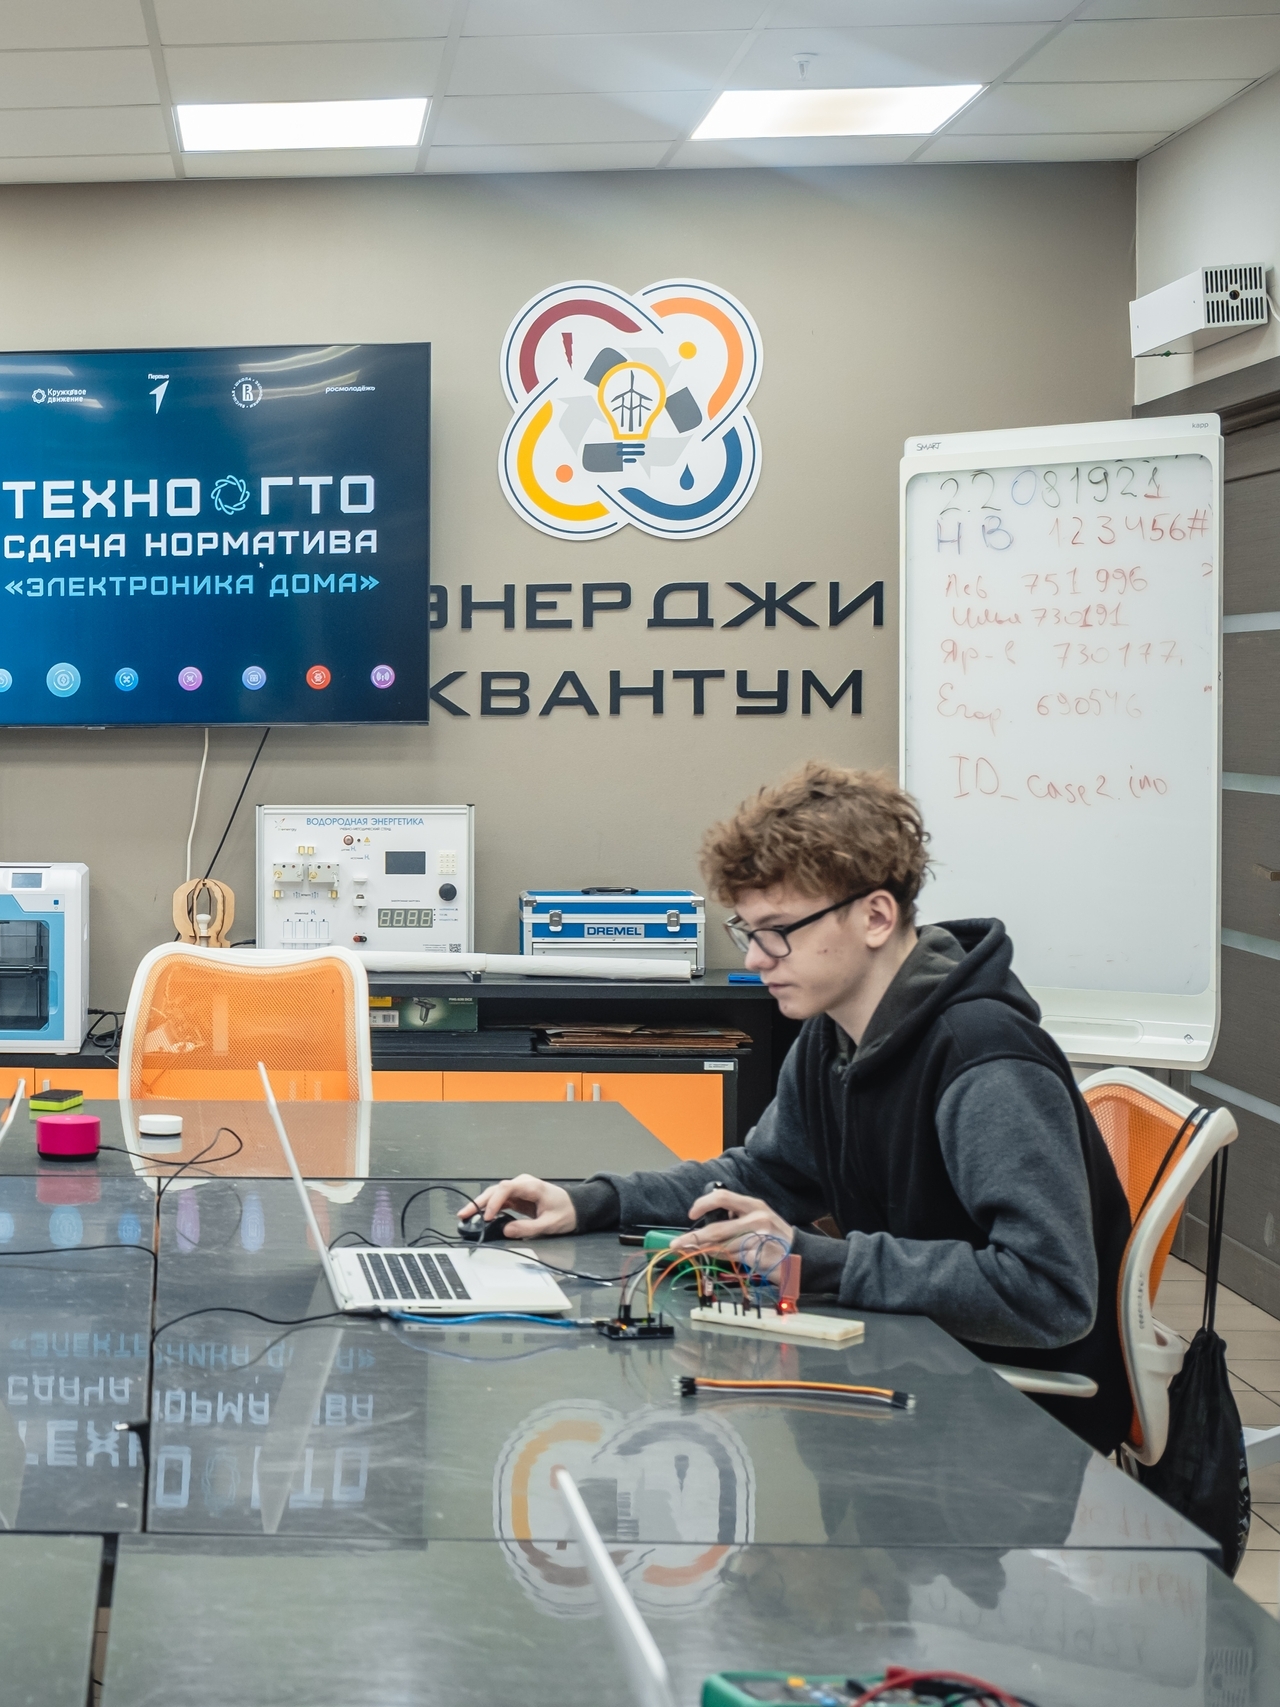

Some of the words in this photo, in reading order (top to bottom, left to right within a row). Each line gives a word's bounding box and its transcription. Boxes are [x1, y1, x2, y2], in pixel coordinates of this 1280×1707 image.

[1191, 421, 1209, 429] kapp
[916, 442, 942, 451] SMART
[2, 478, 201, 519] ТЕХНО
[260, 475, 375, 515] ГТО
[3, 533, 126, 563] СДАЧА
[145, 529, 378, 558] НОРМАТИВА
[4, 574, 254, 597] «ЭЛЕКТРОНИКА
[269, 573, 380, 597] ДОМА»
[429, 669, 863, 717] КВАНТУМ
[306, 818, 368, 826] ВОДОРОДНАЯ
[371, 818, 425, 826] ЭНЕРГЕТИКА
[587, 927, 642, 936] DREMEL
